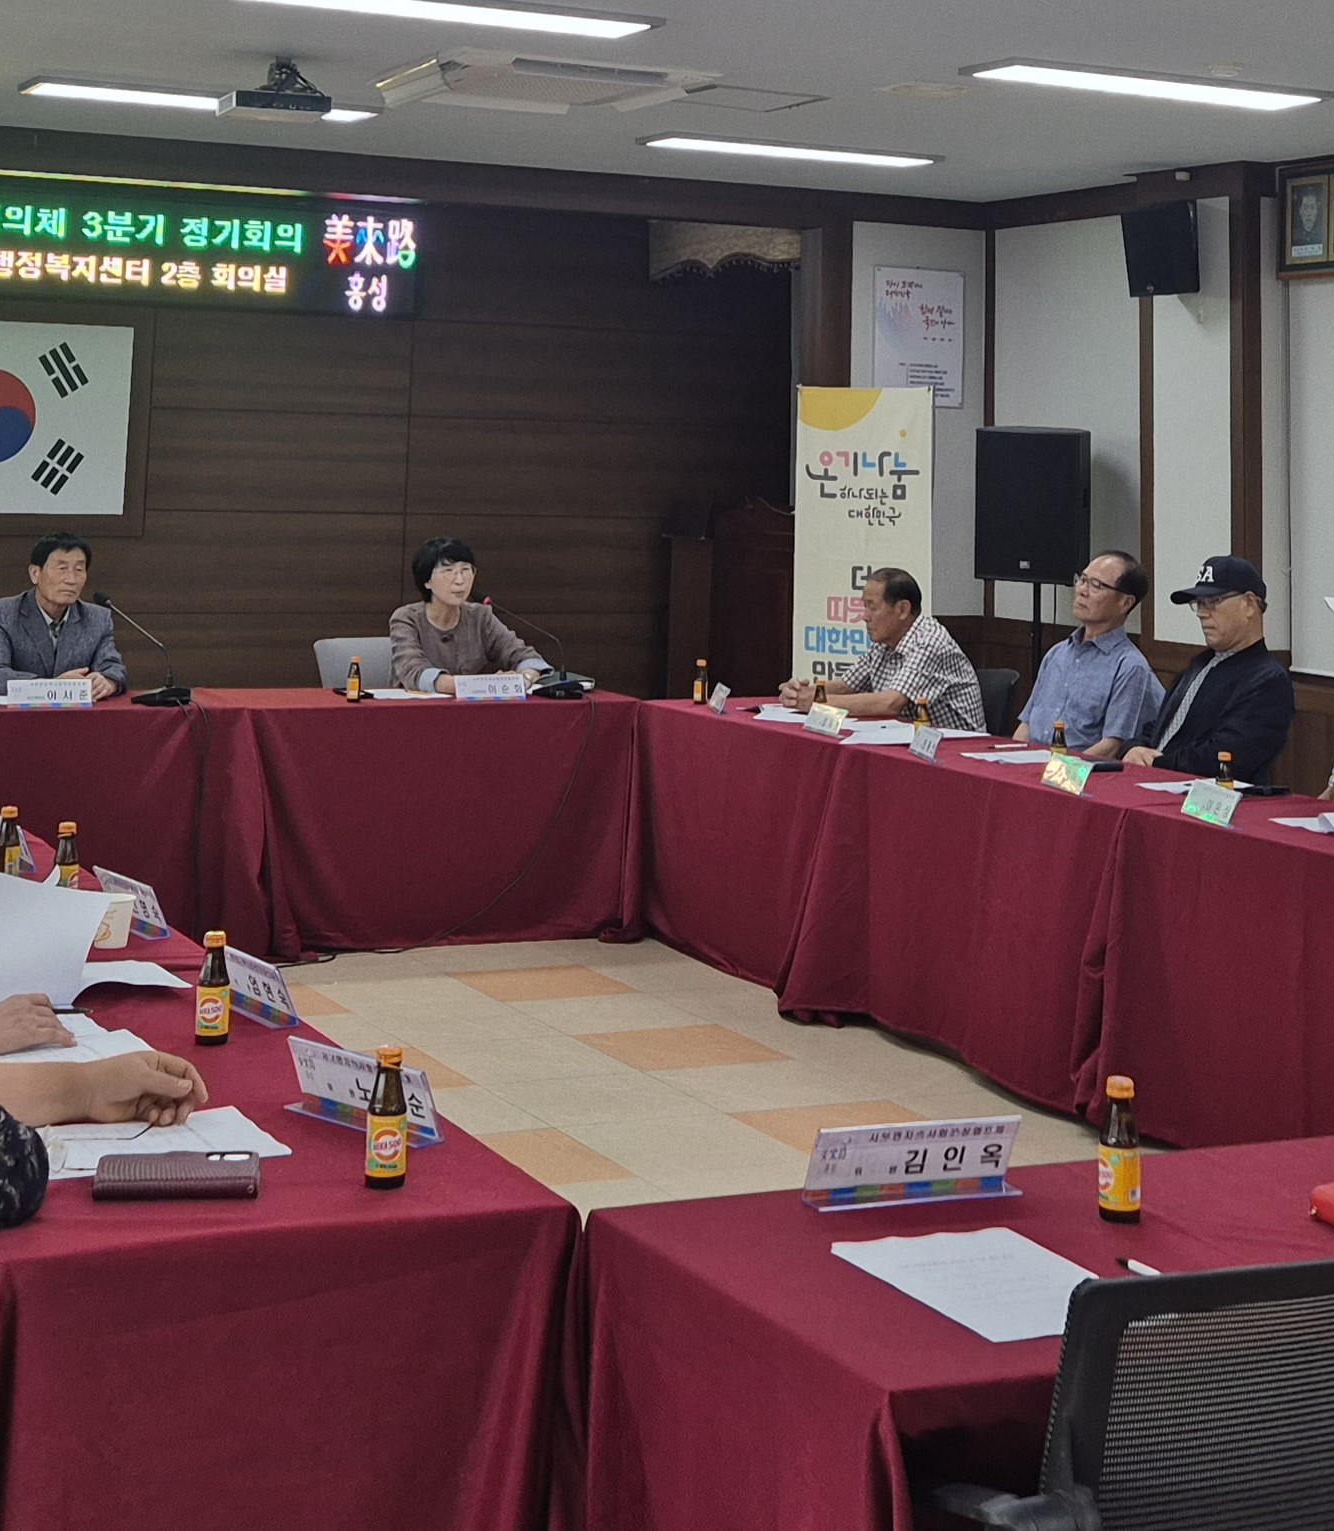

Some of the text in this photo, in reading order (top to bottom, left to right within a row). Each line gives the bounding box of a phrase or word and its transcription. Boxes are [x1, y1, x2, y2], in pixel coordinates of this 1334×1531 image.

[82, 210, 164, 246] 3분기
[180, 216, 304, 253] 정기회의
[161, 260, 201, 290] 2층
[210, 263, 289, 294] 회의실
[344, 271, 388, 312] 홍성
[805, 450, 920, 500] 온기나눔
[839, 485, 889, 505] 하나되는
[848, 504, 902, 526] 대한민국
[804, 625, 873, 656] 대한민
